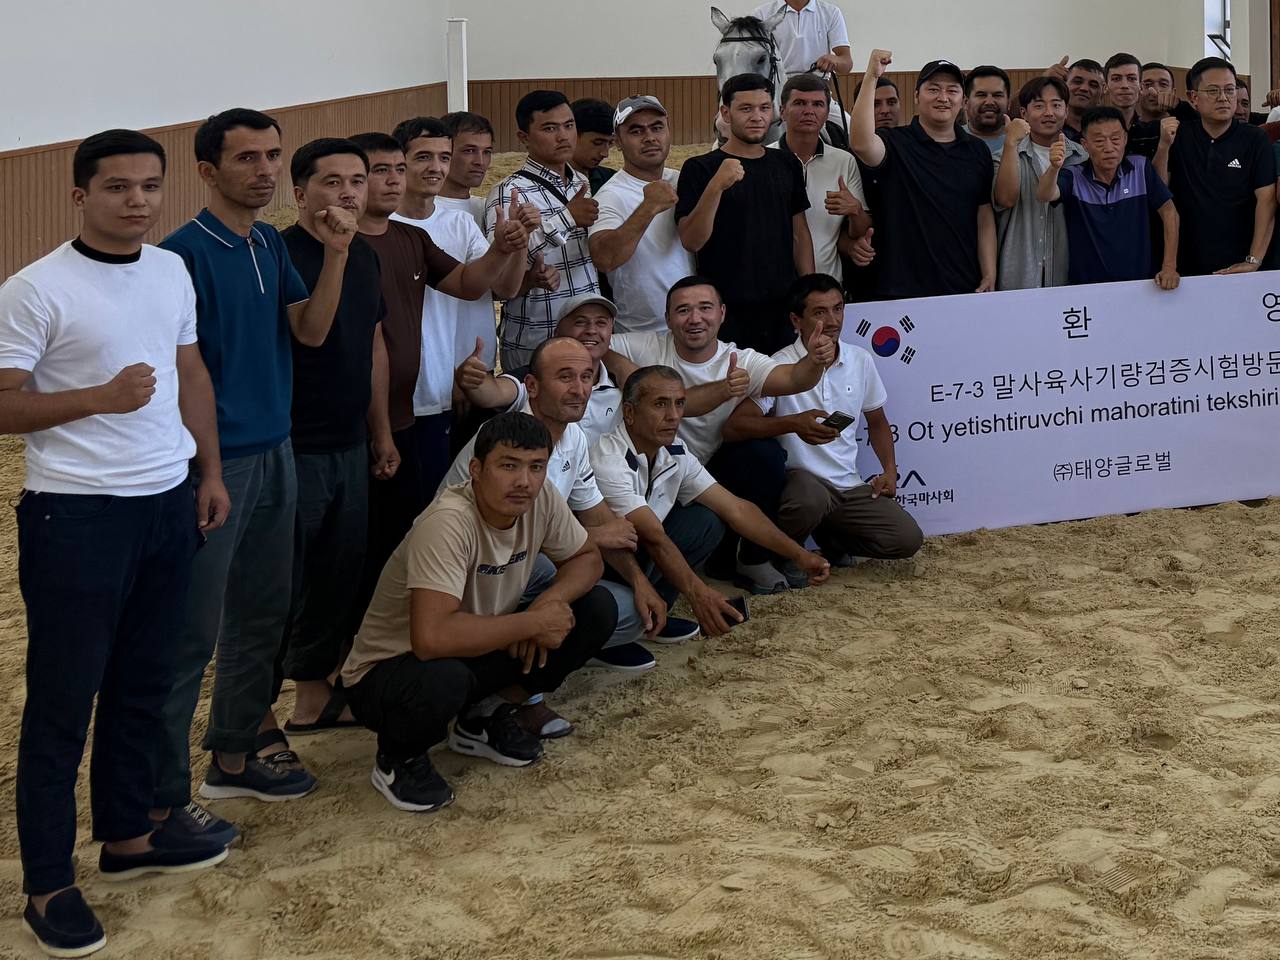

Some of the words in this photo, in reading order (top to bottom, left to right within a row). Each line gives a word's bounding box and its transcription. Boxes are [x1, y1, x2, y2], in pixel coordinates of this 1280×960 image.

[1062, 305, 1092, 340] 환
[930, 381, 984, 403] E-7-3
[908, 421, 935, 442] Ot
[941, 405, 1083, 444] yetishtiruvchi
[1091, 394, 1200, 423] mahoratini
